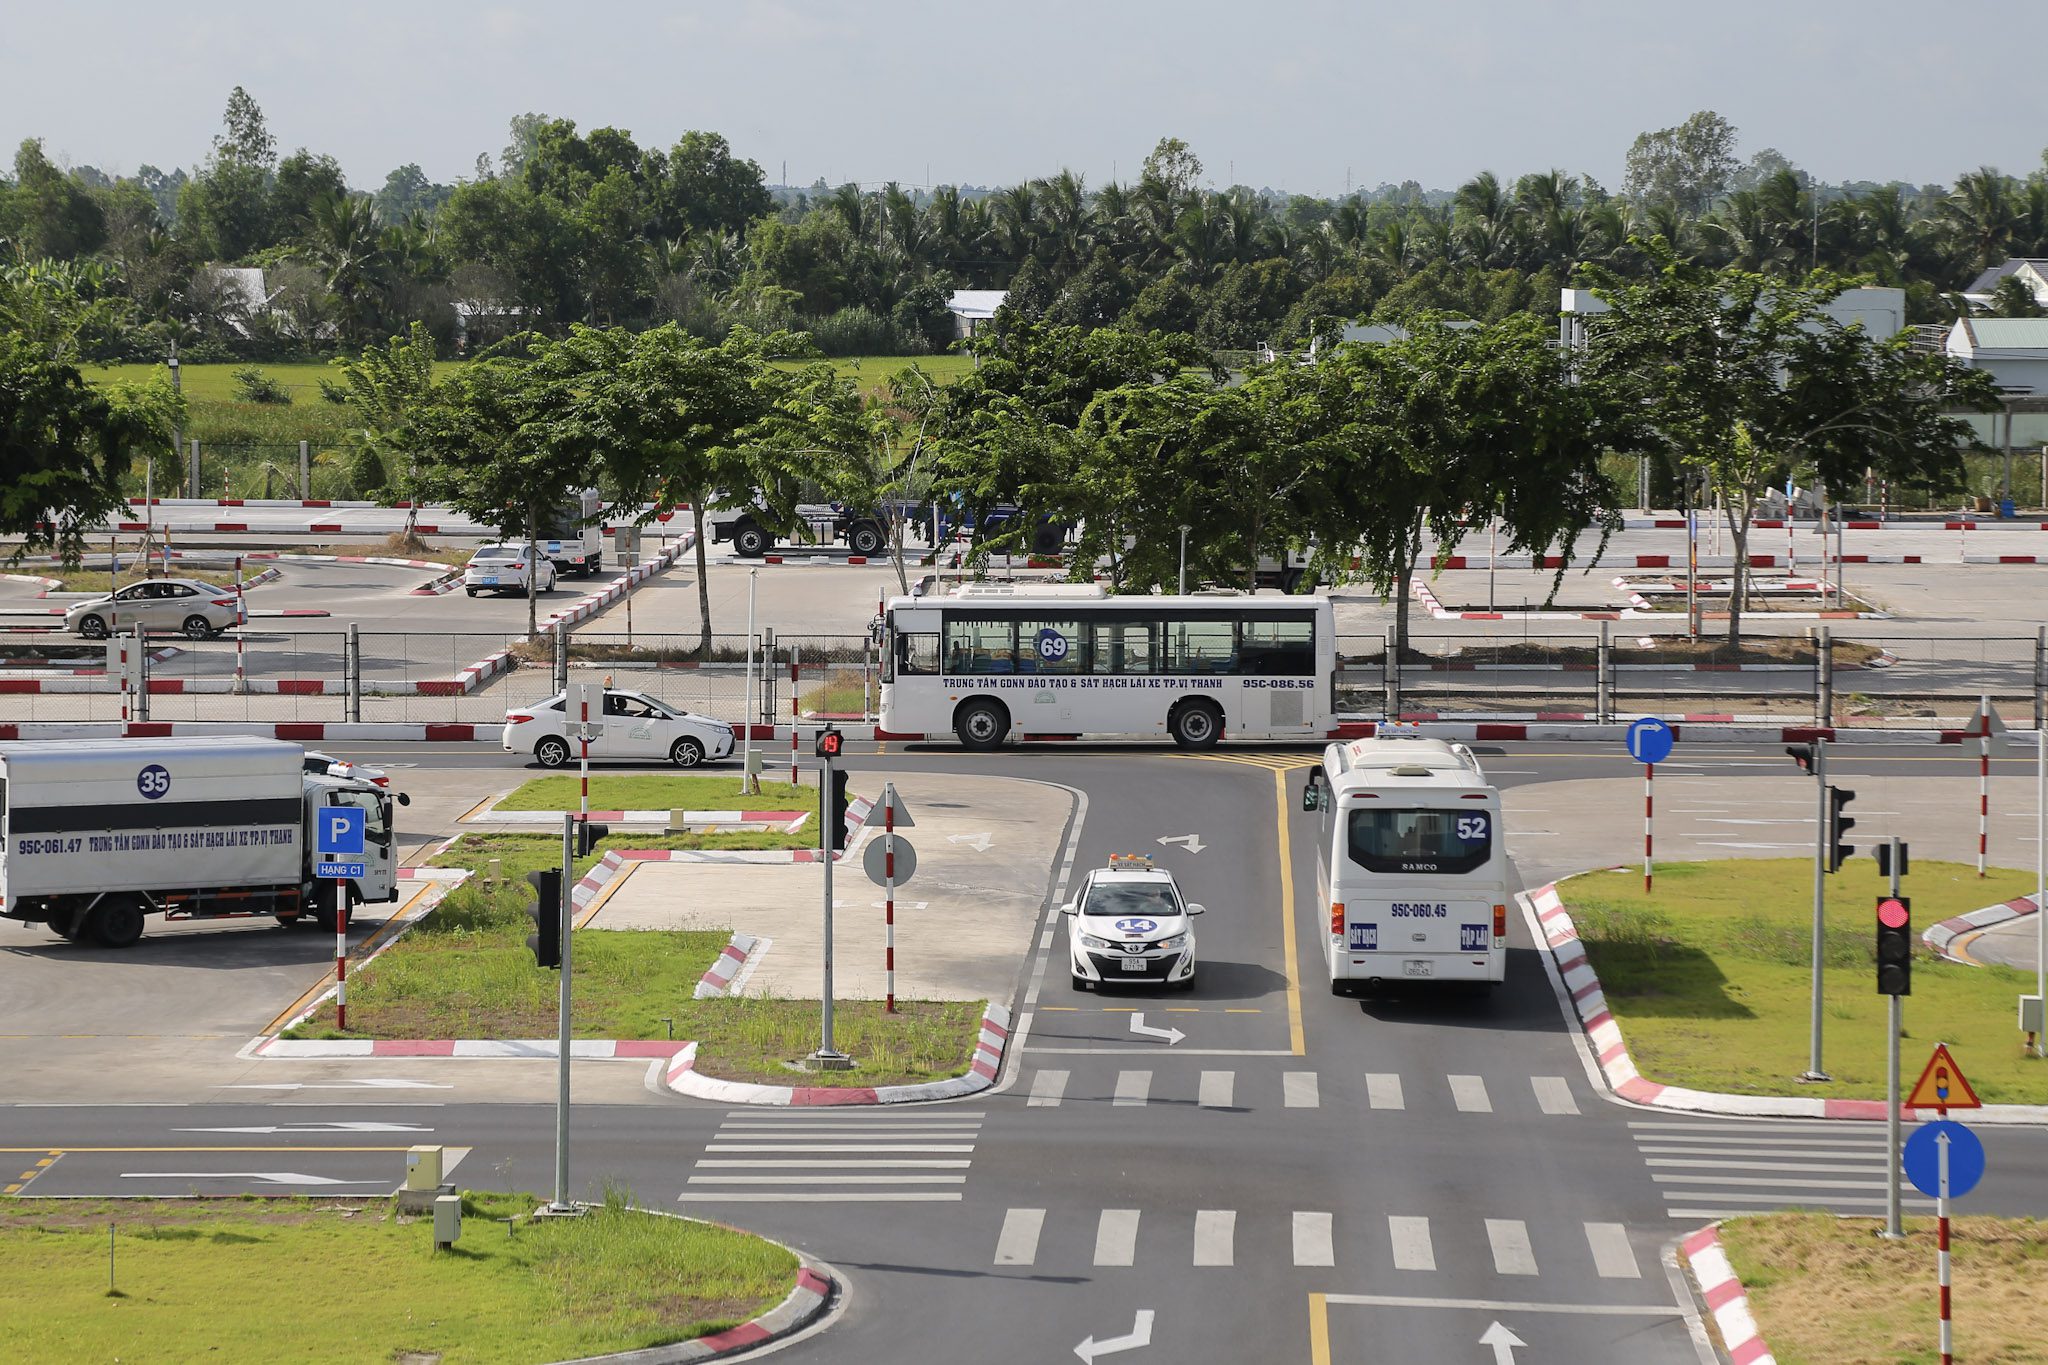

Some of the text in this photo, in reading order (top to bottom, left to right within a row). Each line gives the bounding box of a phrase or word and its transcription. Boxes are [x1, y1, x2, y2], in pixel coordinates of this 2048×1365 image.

[1041, 637, 1066, 656] 69
[943, 679, 974, 688] TRUNG
[977, 677, 997, 688] TÂM
[1000, 679, 1025, 688] GDNN
[1049, 679, 1068, 690] TẠO
[1070, 679, 1077, 688] &
[1080, 677, 1099, 688] SÁT
[1102, 679, 1127, 690] HẠCH
[1148, 679, 1160, 688] XE
[1191, 679, 1222, 688] THANH
[1243, 680, 1314, 688] 95C-086.56
[141, 771, 168, 792] 35
[331, 817, 351, 843] P
[1457, 817, 1486, 839] 52
[19, 838, 82, 854] 95C-061.47
[89, 836, 112, 852] TRUNG
[132, 835, 150, 850] GDNN
[168, 834, 182, 851] TẠO
[184, 833, 188, 848] &
[206, 832, 224, 851] HẠCH
[239, 831, 248, 846] XE
[270, 829, 293, 844] THANH
[321, 866, 361, 876] HẠNG C1
[1402, 863, 1437, 871] SAMCO
[1391, 903, 1447, 918] 95C-060.45
[1120, 920, 1152, 930] 14
